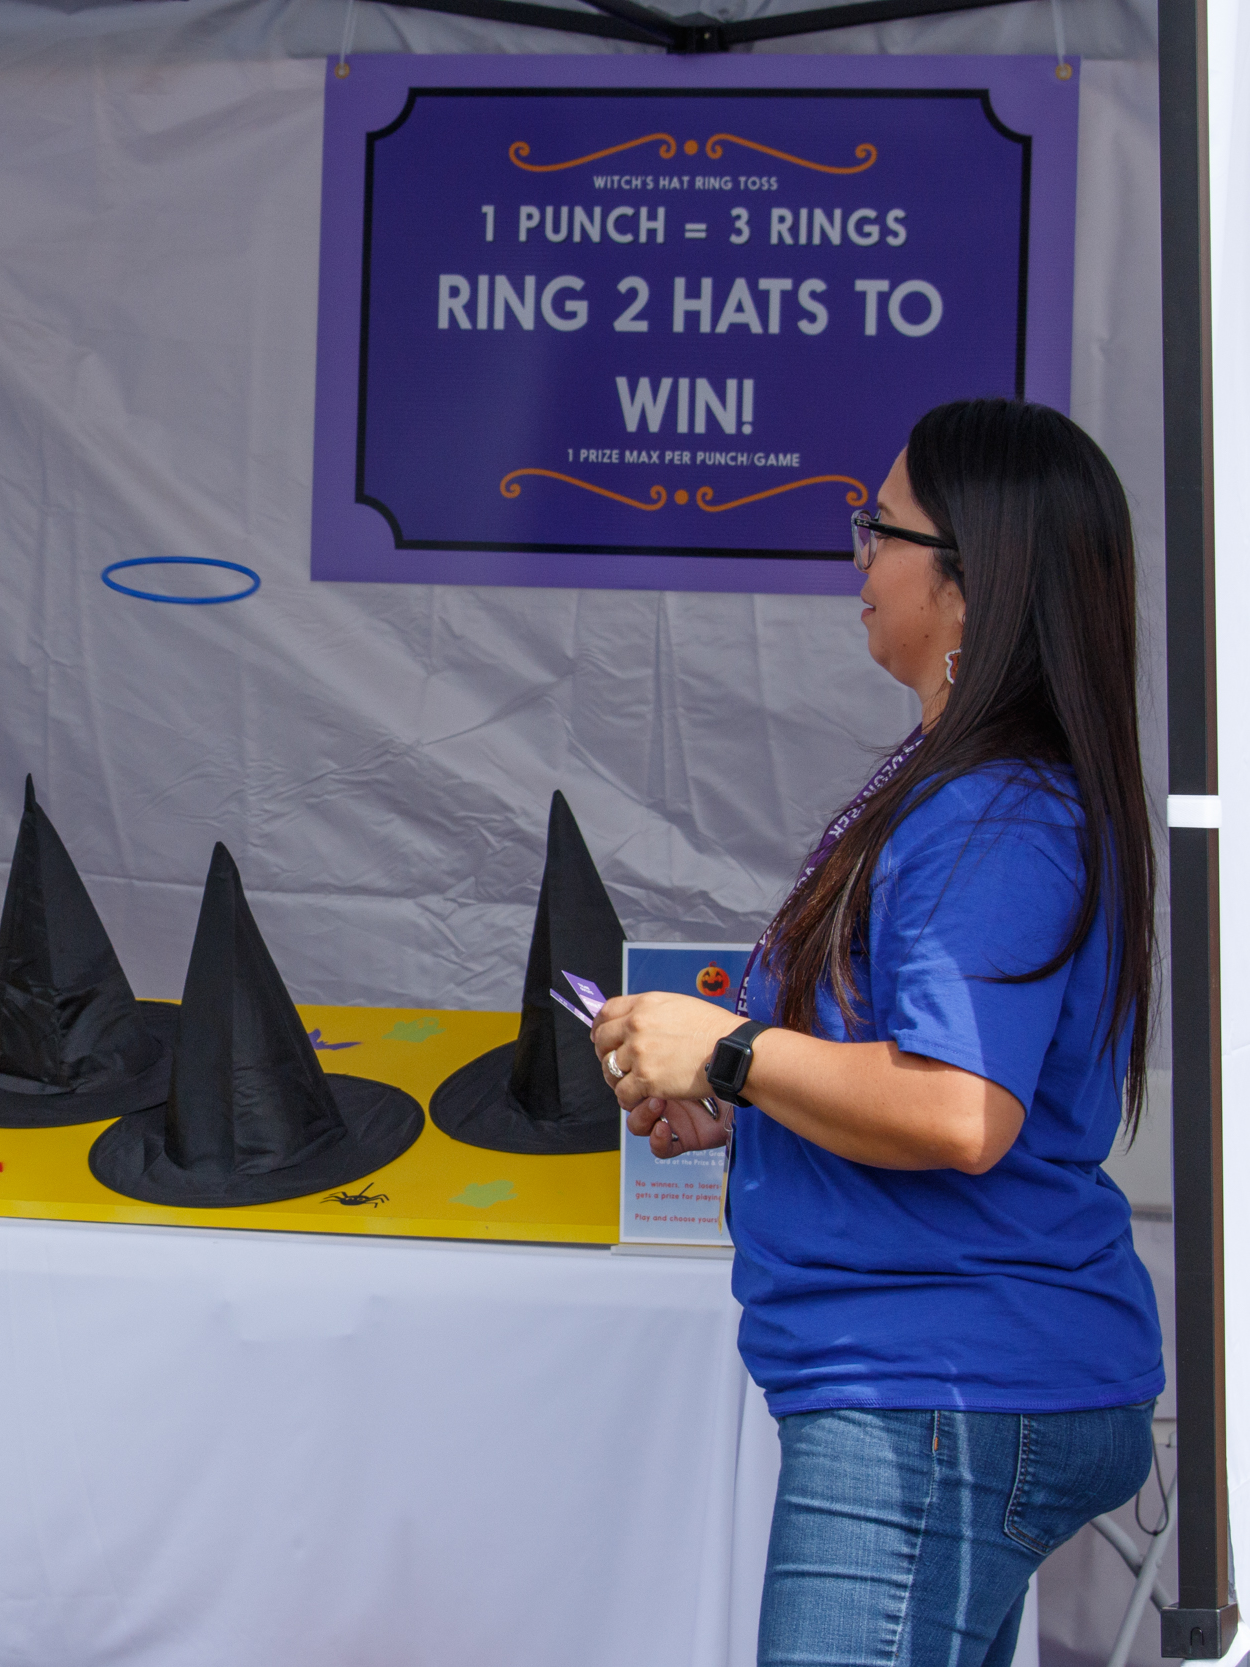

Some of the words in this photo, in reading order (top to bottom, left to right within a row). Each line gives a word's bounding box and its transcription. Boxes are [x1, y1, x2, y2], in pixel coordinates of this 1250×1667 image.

[593, 175, 654, 190] WITCH'S
[659, 176, 690, 190] HAT
[695, 176, 733, 191] RING
[738, 176, 779, 191] TOSS
[481, 205, 495, 243] 1
[518, 205, 666, 244] PUNCH
[684, 223, 707, 239] =
[729, 207, 750, 244] 3
[770, 207, 908, 246] RINGS
[436, 273, 589, 332] RING
[612, 276, 650, 333] 2
[671, 276, 830, 335] HATS
[854, 279, 944, 337] TO
[615, 376, 755, 435] WIN!
[567, 449, 574, 463] 1
[579, 449, 620, 463] PRIZE
[624, 450, 660, 464] MAX
[664, 450, 691, 465] PER
[696, 451, 801, 467] PUNCH/GAME
[635, 1192, 651, 1200] gets
[661, 1192, 679, 1200] prize
[635, 1213, 650, 1222] Play
[669, 1215, 696, 1223] choose
